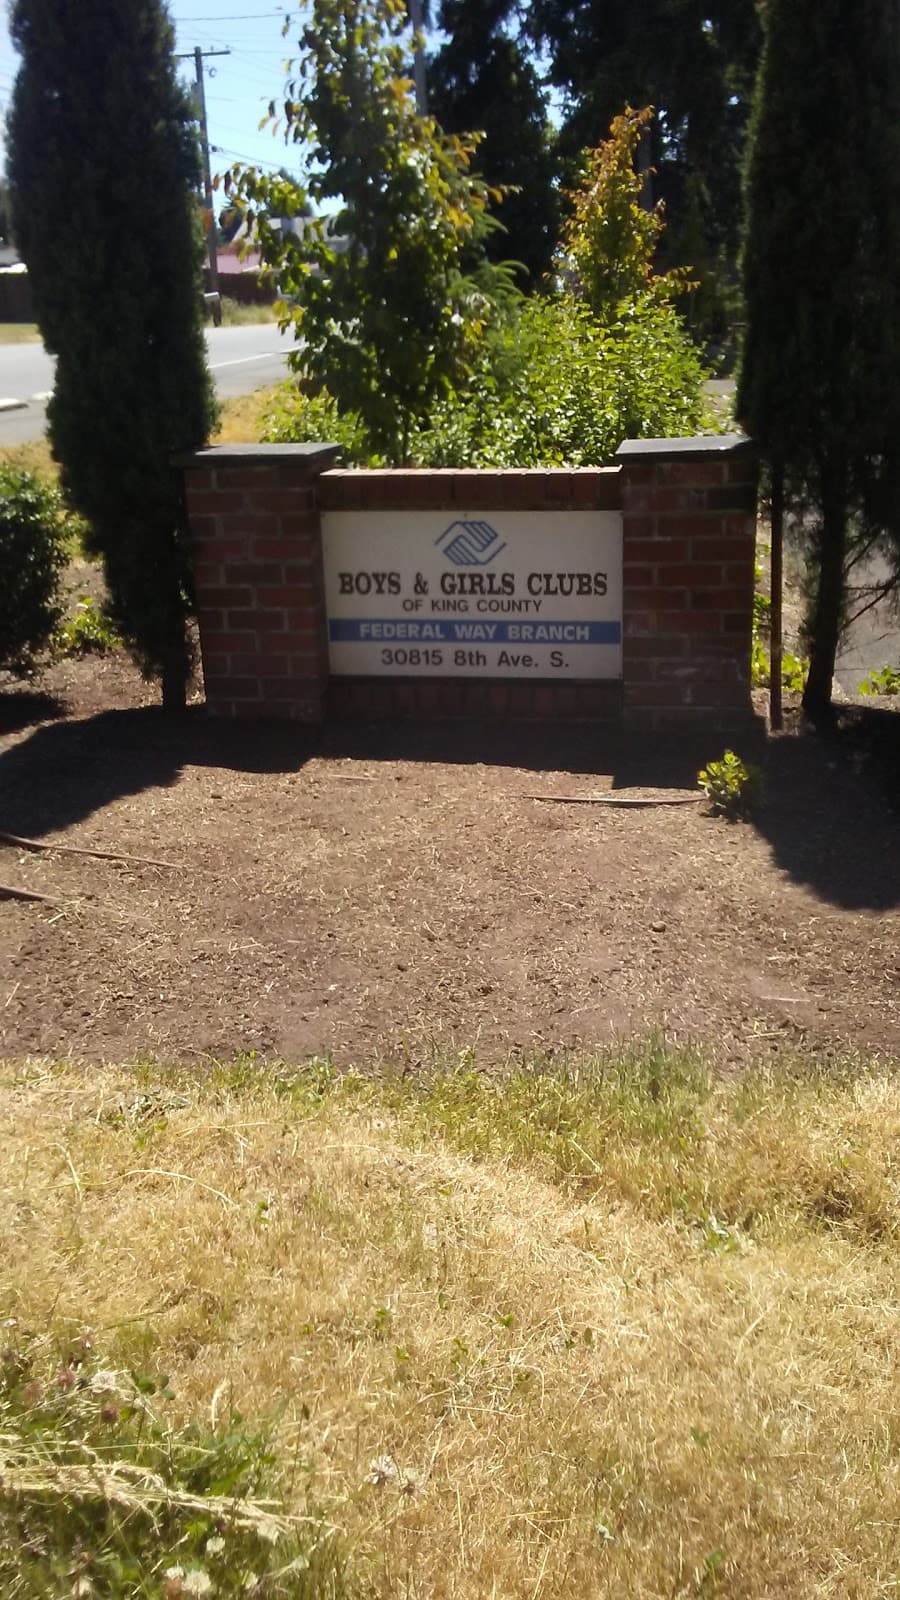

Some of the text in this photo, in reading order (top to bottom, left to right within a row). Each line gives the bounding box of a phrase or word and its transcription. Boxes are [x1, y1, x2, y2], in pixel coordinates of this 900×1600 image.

[338, 572, 608, 597] BOYS & GIRLS CLUBS
[402, 599, 543, 614] OF KING COUNTY
[359, 623, 590, 641] FEDERAL WAY BRANCH
[381, 649, 570, 668] 30815 8th Ave. S.
